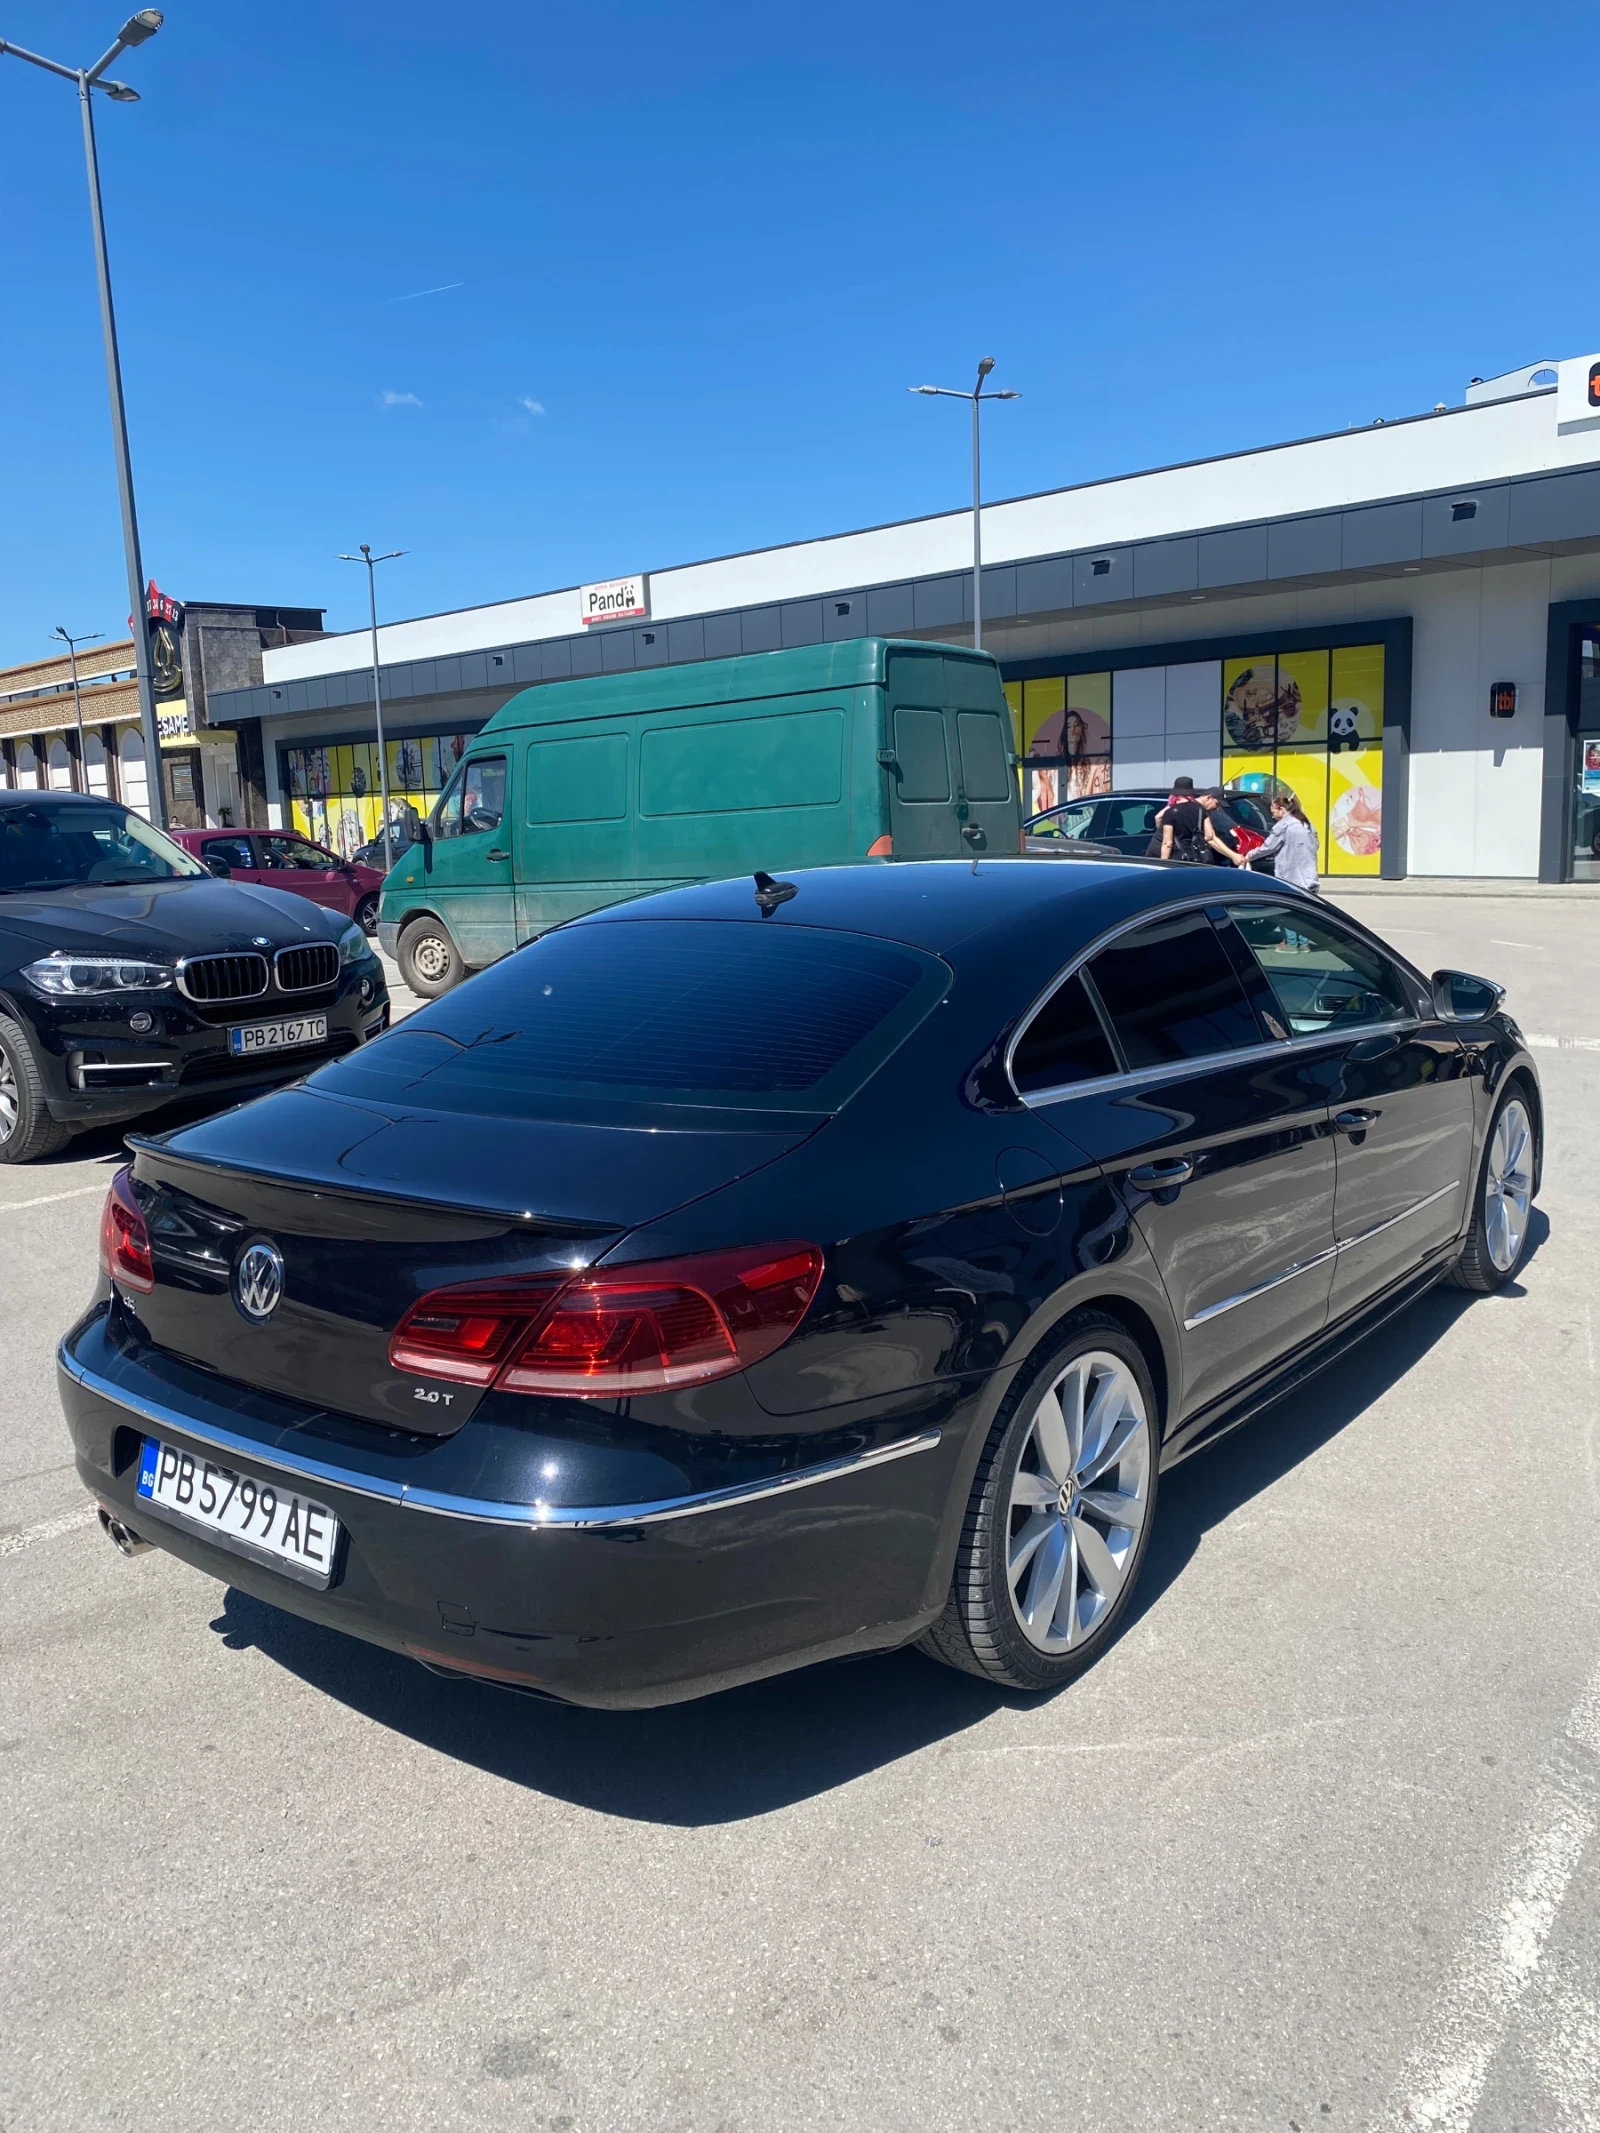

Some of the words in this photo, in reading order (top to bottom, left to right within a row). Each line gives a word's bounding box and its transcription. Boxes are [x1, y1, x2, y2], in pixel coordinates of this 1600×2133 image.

[244, 1029, 265, 1048] PB
[268, 1022, 304, 1044] 2167
[307, 1019, 325, 1038] TC
[442, 1393, 454, 1405] T
[142, 1471, 154, 1488] BG
[157, 1446, 196, 1505] PB
[199, 1462, 278, 1539] 5799
[281, 1495, 328, 1562] AE
